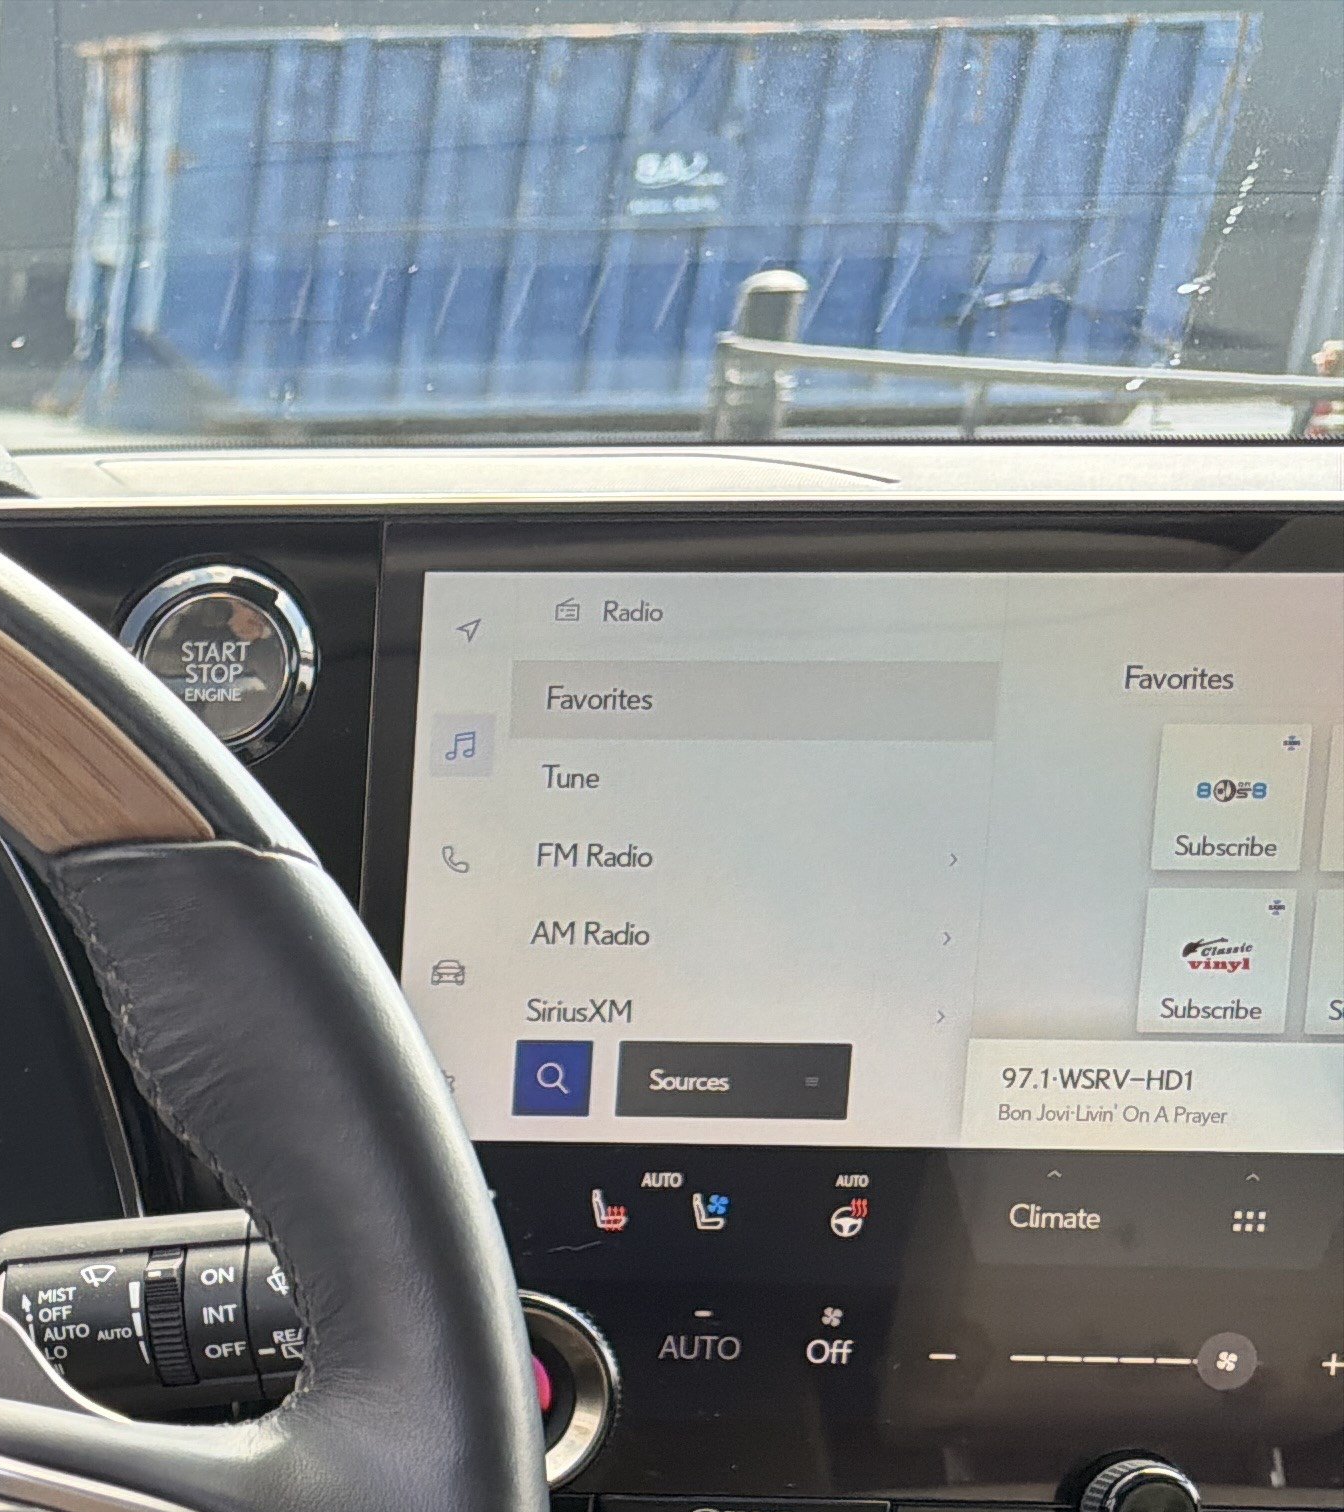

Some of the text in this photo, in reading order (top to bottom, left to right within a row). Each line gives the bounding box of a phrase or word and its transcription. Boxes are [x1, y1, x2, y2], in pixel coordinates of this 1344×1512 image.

[603, 600, 663, 621] Radio
[181, 641, 251, 662] START
[185, 663, 244, 684] STOP
[1124, 664, 1234, 690] Favorites
[185, 688, 242, 702] ENGINE
[546, 685, 653, 710] Favorites
[541, 763, 600, 789] Tune
[537, 842, 653, 868] FM Radio
[1174, 835, 1278, 857] Subscribe
[530, 920, 650, 946] AM Radio
[1201, 942, 1254, 957] Classic
[1187, 957, 1251, 973] vinyl
[526, 998, 632, 1024] SiriusXM
[1161, 998, 1263, 1020] Subscribe
[649, 1068, 730, 1091] Sources
[998, 1103, 1032, 1121] Bon
[1122, 1105, 1149, 1123] On
[1154, 1106, 1169, 1123] A
[1174, 1106, 1228, 1127] Prayer
[640, 1172, 683, 1188] AUTO
[835, 1174, 870, 1188] AUTO
[1009, 1203, 1101, 1230] Climate
[200, 1266, 234, 1286] ON
[38, 1287, 77, 1304] MIST
[38, 1305, 72, 1322] OFF
[202, 1304, 238, 1324] INT
[43, 1324, 90, 1342] AUTO
[97, 1327, 132, 1341] AUTO
[44, 1345, 68, 1360] LO
[205, 1341, 247, 1359] OFF
[658, 1335, 741, 1361] AUTO
[806, 1339, 854, 1364] Off
